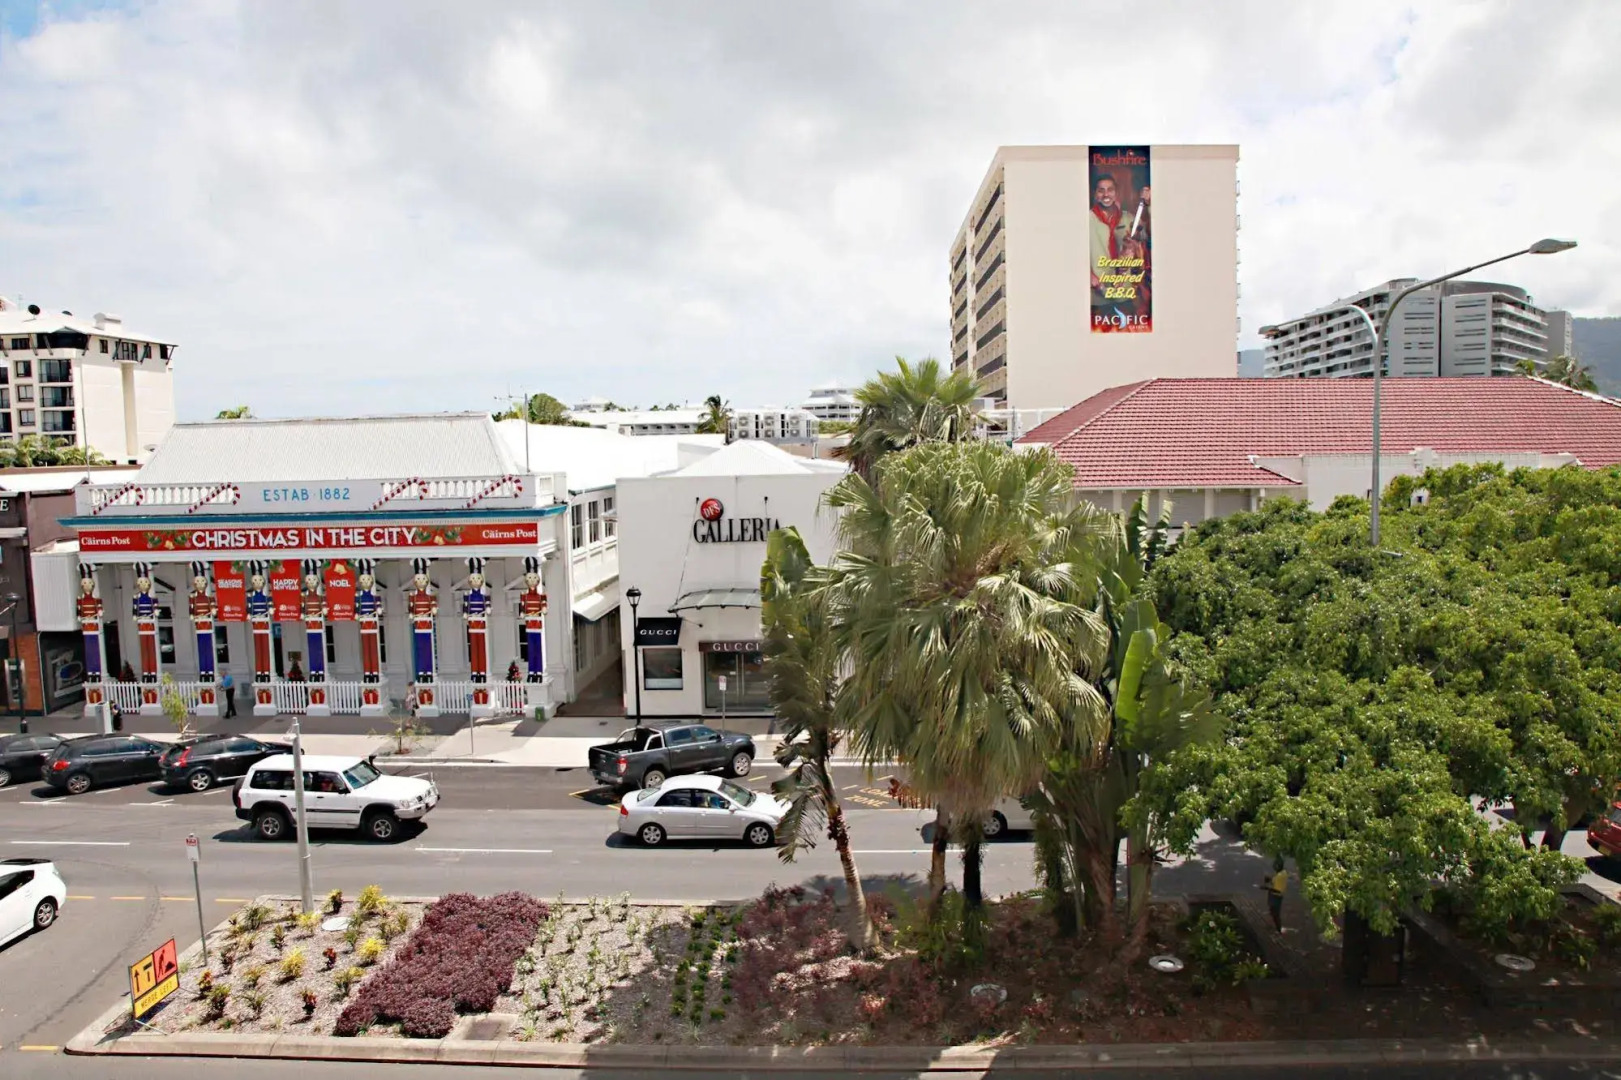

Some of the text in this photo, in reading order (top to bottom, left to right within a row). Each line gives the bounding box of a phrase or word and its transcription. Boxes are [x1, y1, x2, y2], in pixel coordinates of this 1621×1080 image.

[1092, 150, 1147, 166] Bushfire
[1097, 255, 1144, 268] Brazilian
[1099, 271, 1144, 285] Inspired
[1094, 313, 1148, 327] PACIFIC
[263, 487, 350, 502] ESTAB 1882
[702, 503, 721, 518] DFS
[191, 527, 417, 548] CHRISTMAS IN THE CITY
[482, 528, 538, 539] Cairns Post
[81, 536, 131, 546] Cairns Post
[273, 578, 298, 586] HAPPY
[329, 579, 351, 587] NOEL
[712, 642, 759, 651] GUCCI
